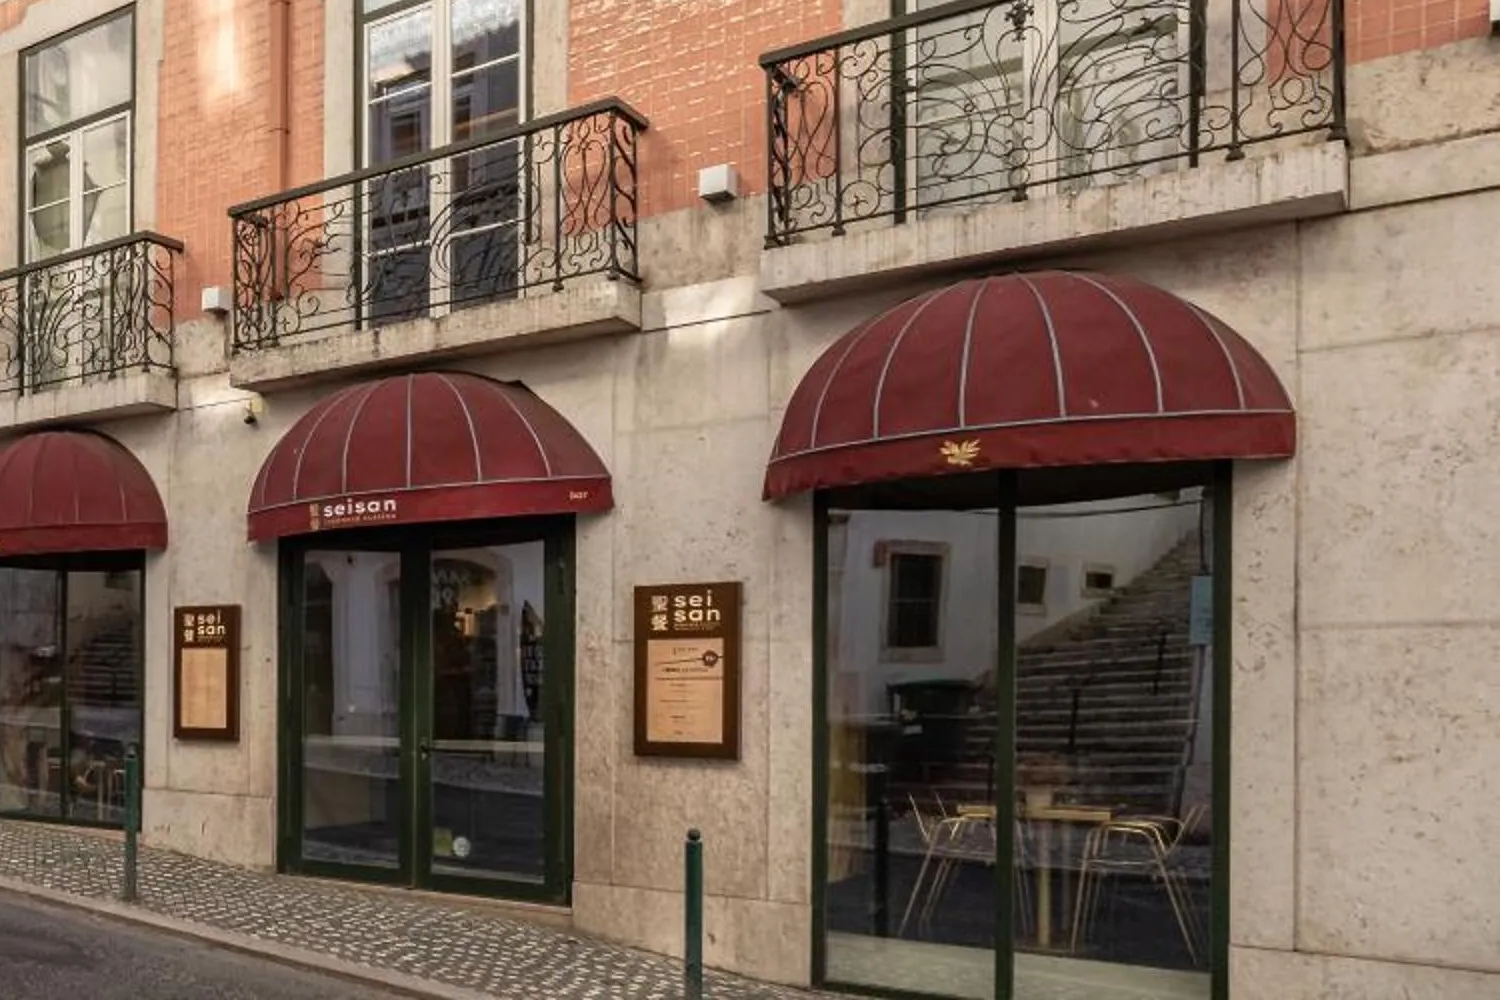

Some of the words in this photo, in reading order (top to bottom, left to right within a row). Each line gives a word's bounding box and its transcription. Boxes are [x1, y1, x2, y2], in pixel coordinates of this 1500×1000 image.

[323, 497, 397, 518] seisan
[673, 589, 712, 608] sei
[197, 609, 221, 625] sei
[673, 609, 721, 623] san
[197, 625, 226, 635] san
